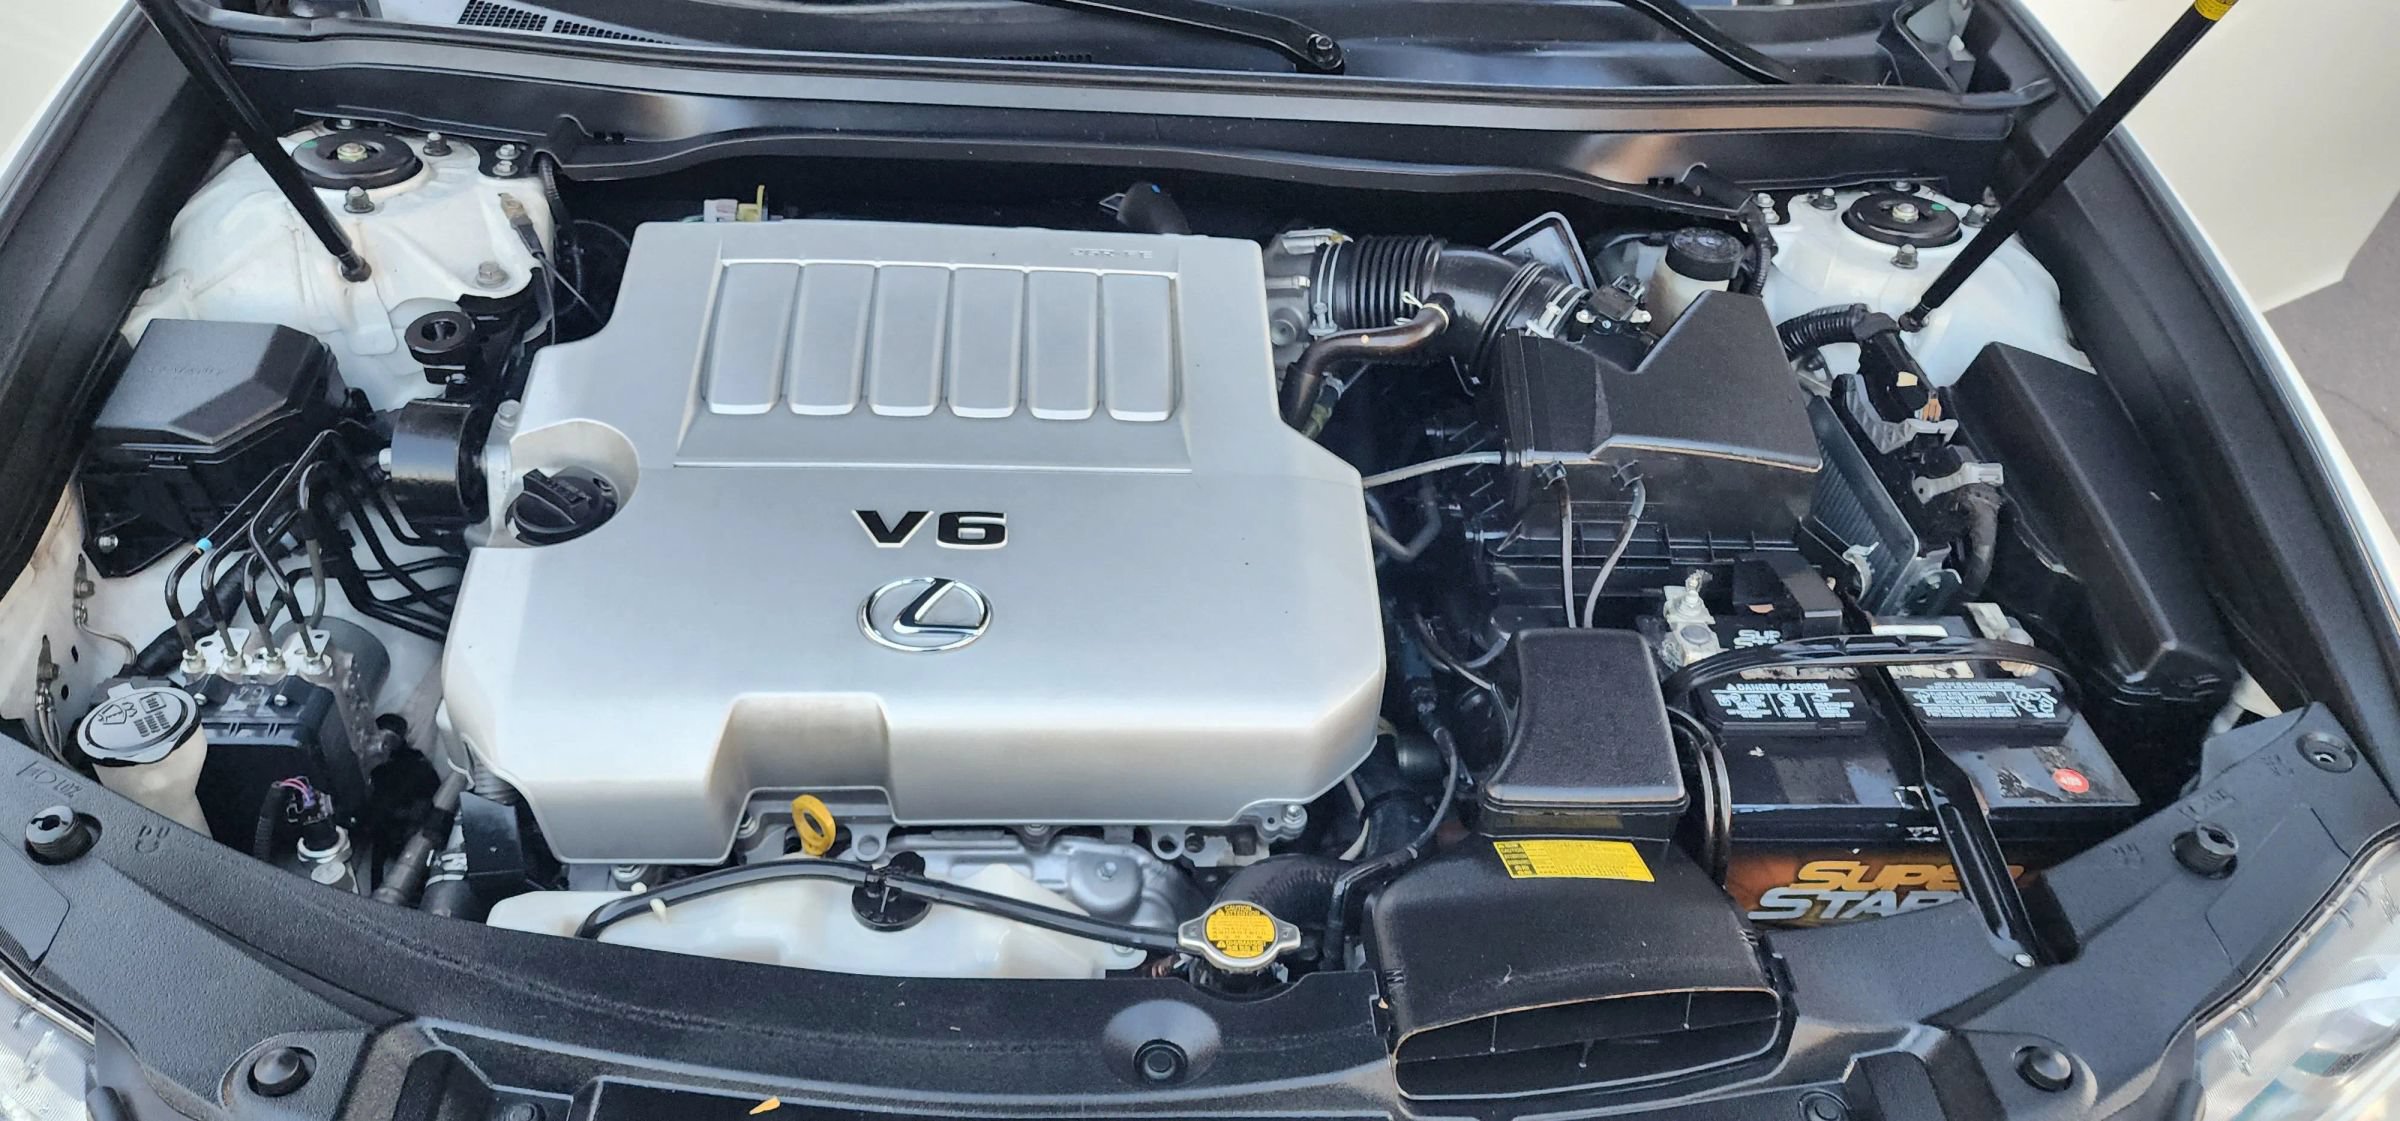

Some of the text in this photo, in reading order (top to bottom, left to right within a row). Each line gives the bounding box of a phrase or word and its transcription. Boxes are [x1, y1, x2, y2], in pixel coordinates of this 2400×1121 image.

[851, 510, 1008, 550] V6
[1737, 629, 1781, 645] SUP
[1790, 860, 2024, 891] SUPE
